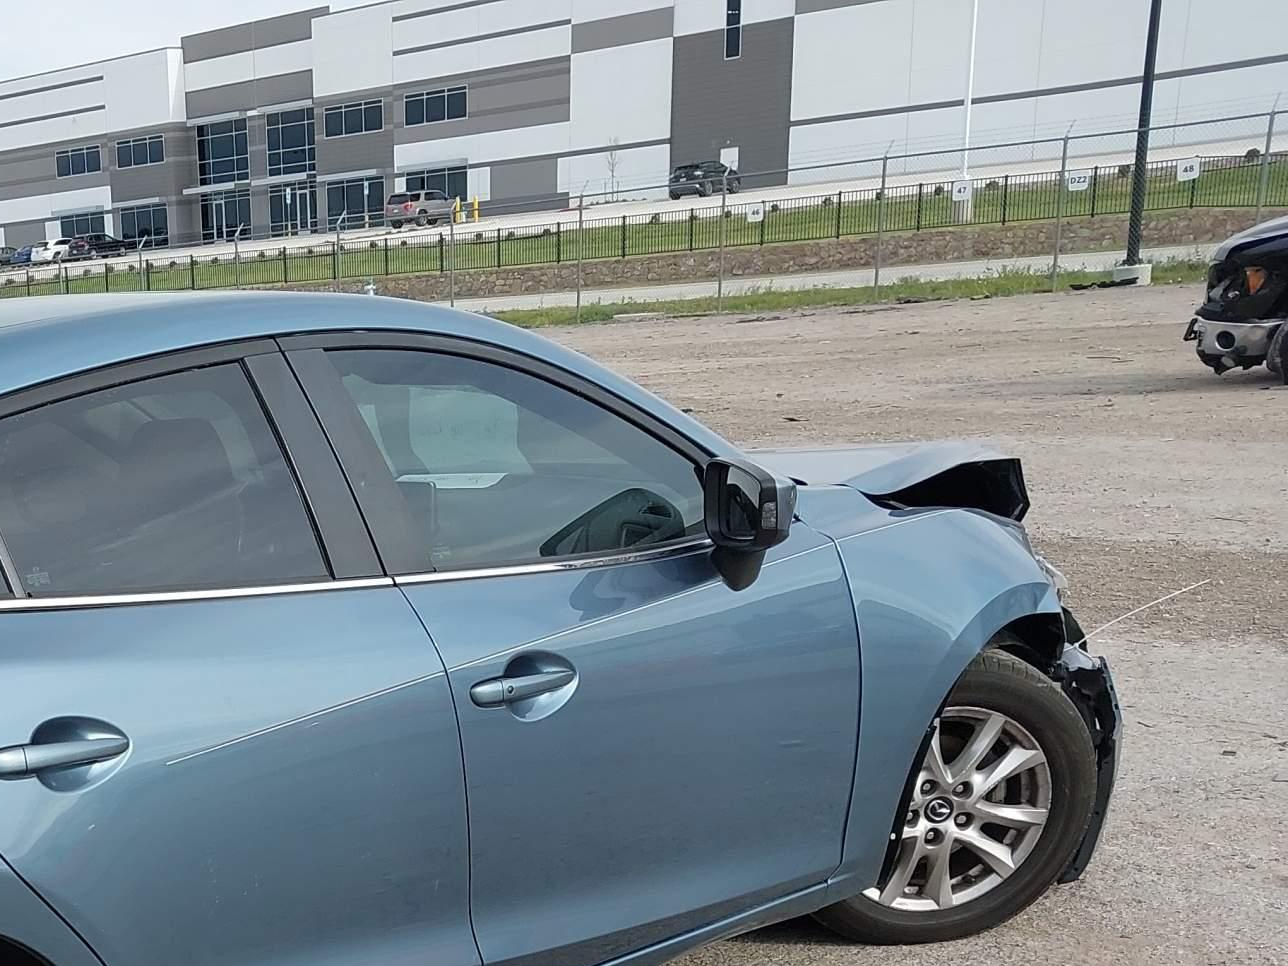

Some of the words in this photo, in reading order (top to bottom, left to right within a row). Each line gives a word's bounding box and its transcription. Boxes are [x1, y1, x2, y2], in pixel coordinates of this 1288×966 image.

[1182, 164, 1195, 173] 48
[1070, 175, 1088, 185] DZ2
[956, 186, 967, 194] 47
